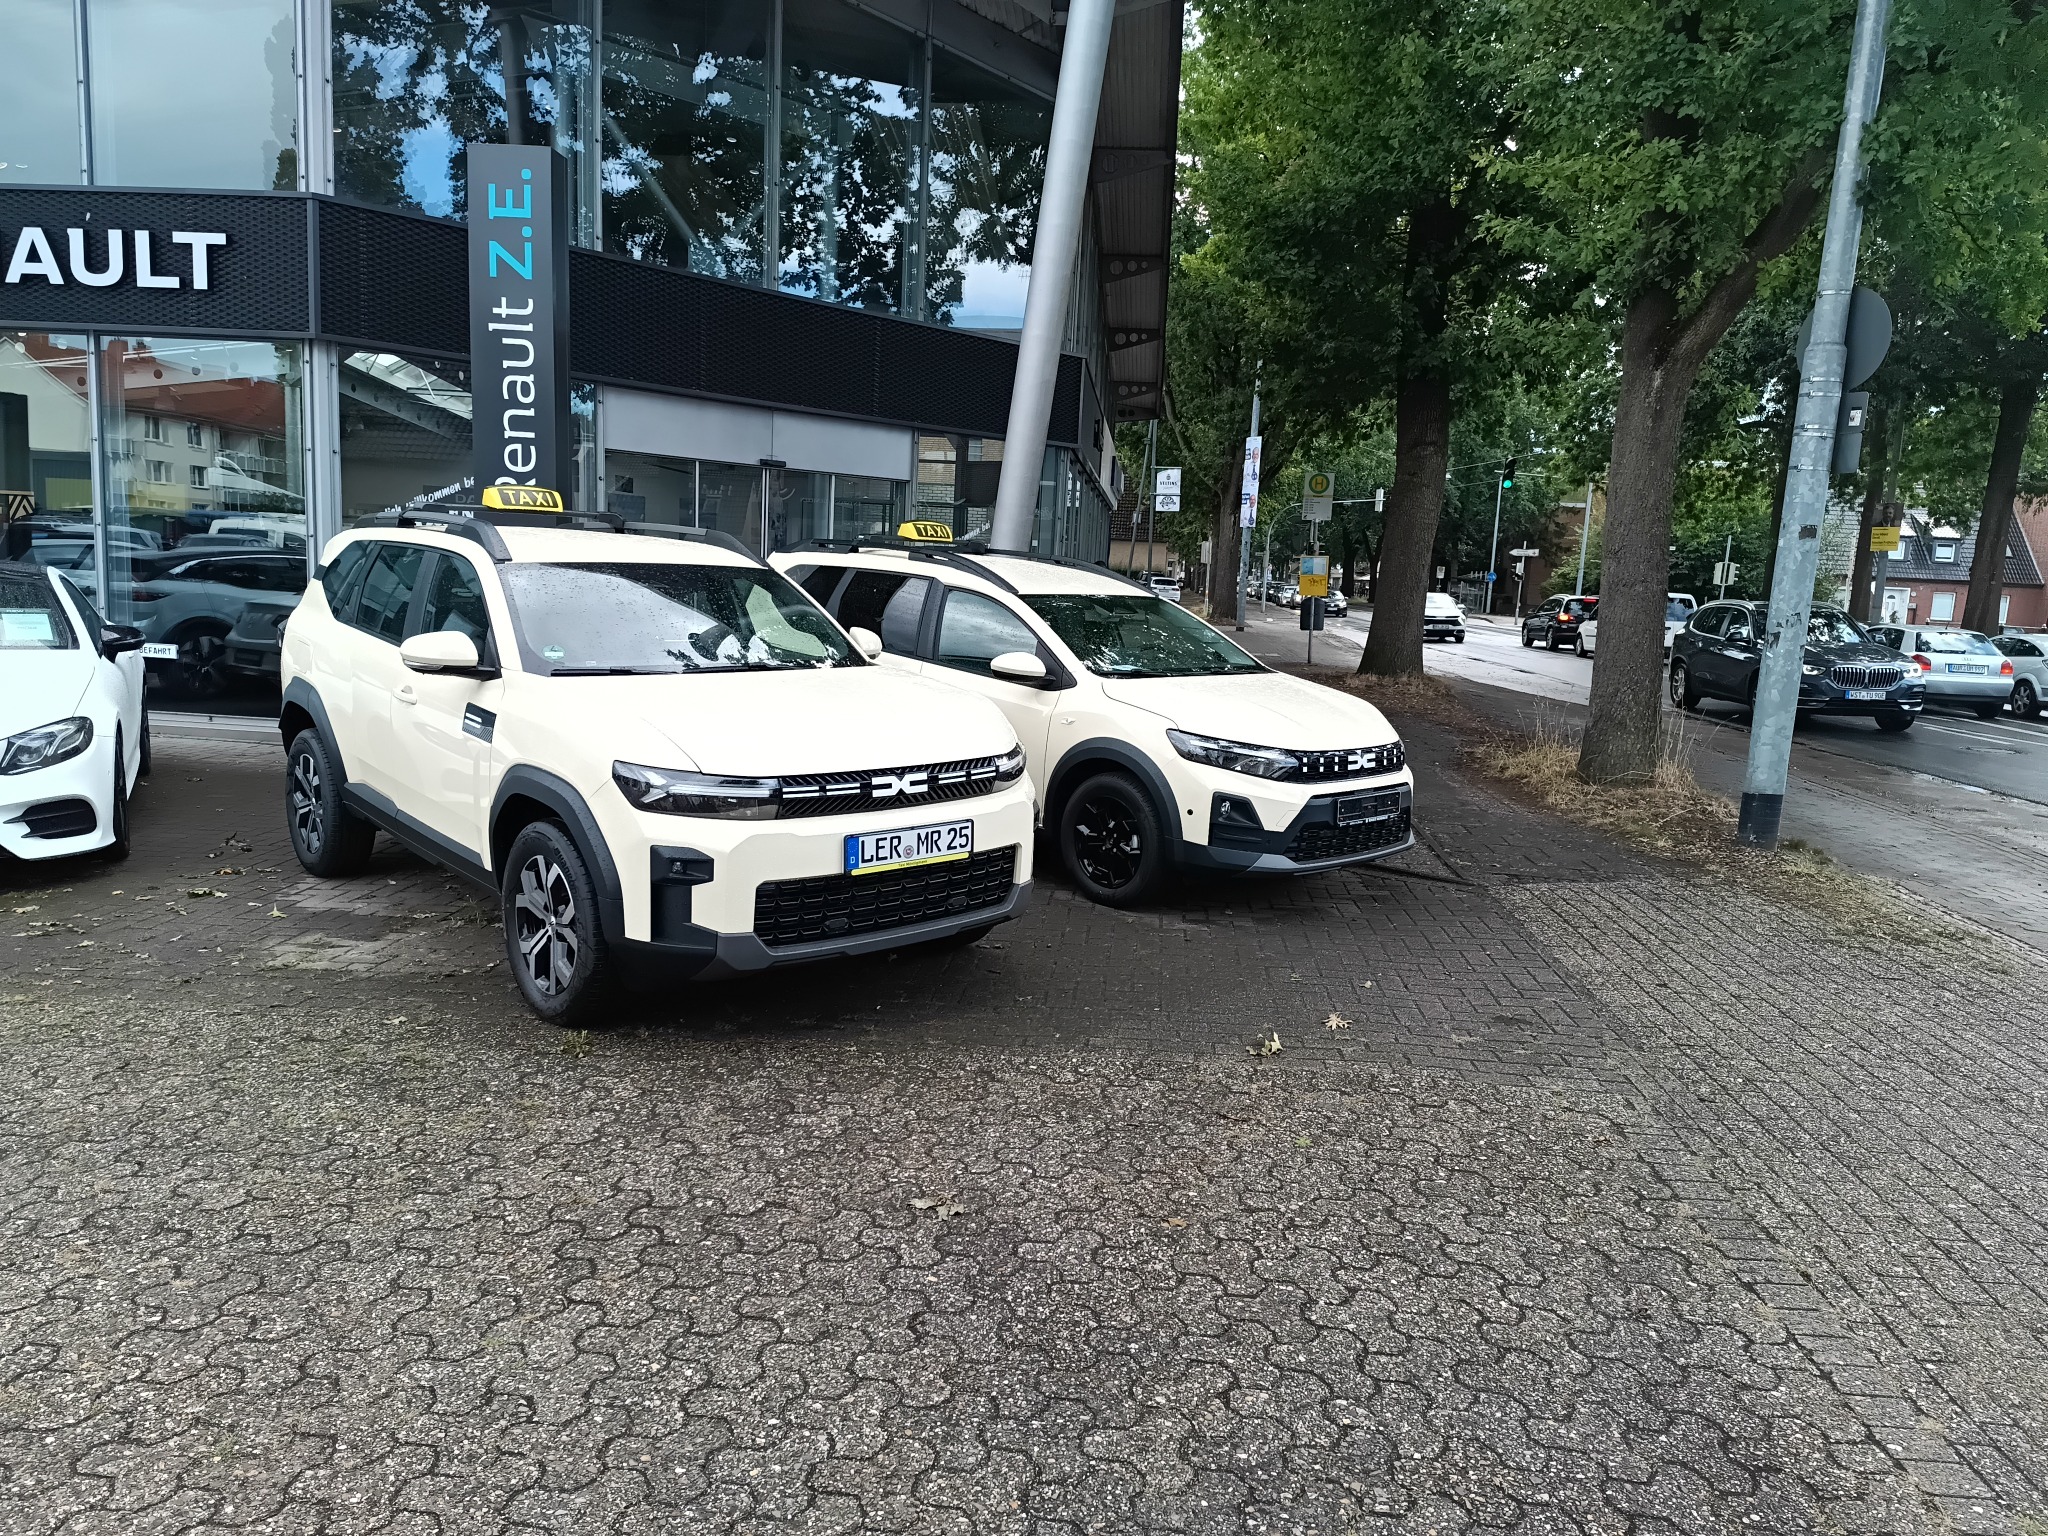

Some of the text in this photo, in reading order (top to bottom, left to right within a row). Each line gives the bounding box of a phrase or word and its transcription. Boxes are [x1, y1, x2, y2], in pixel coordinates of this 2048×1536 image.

[488, 168, 534, 280] Z.E.
[5, 226, 226, 291] AULT
[1315, 478, 1323, 489] H
[503, 490, 554, 507] TAXI
[916, 524, 948, 538] TAXI
[861, 825, 970, 864] LER MR 25
